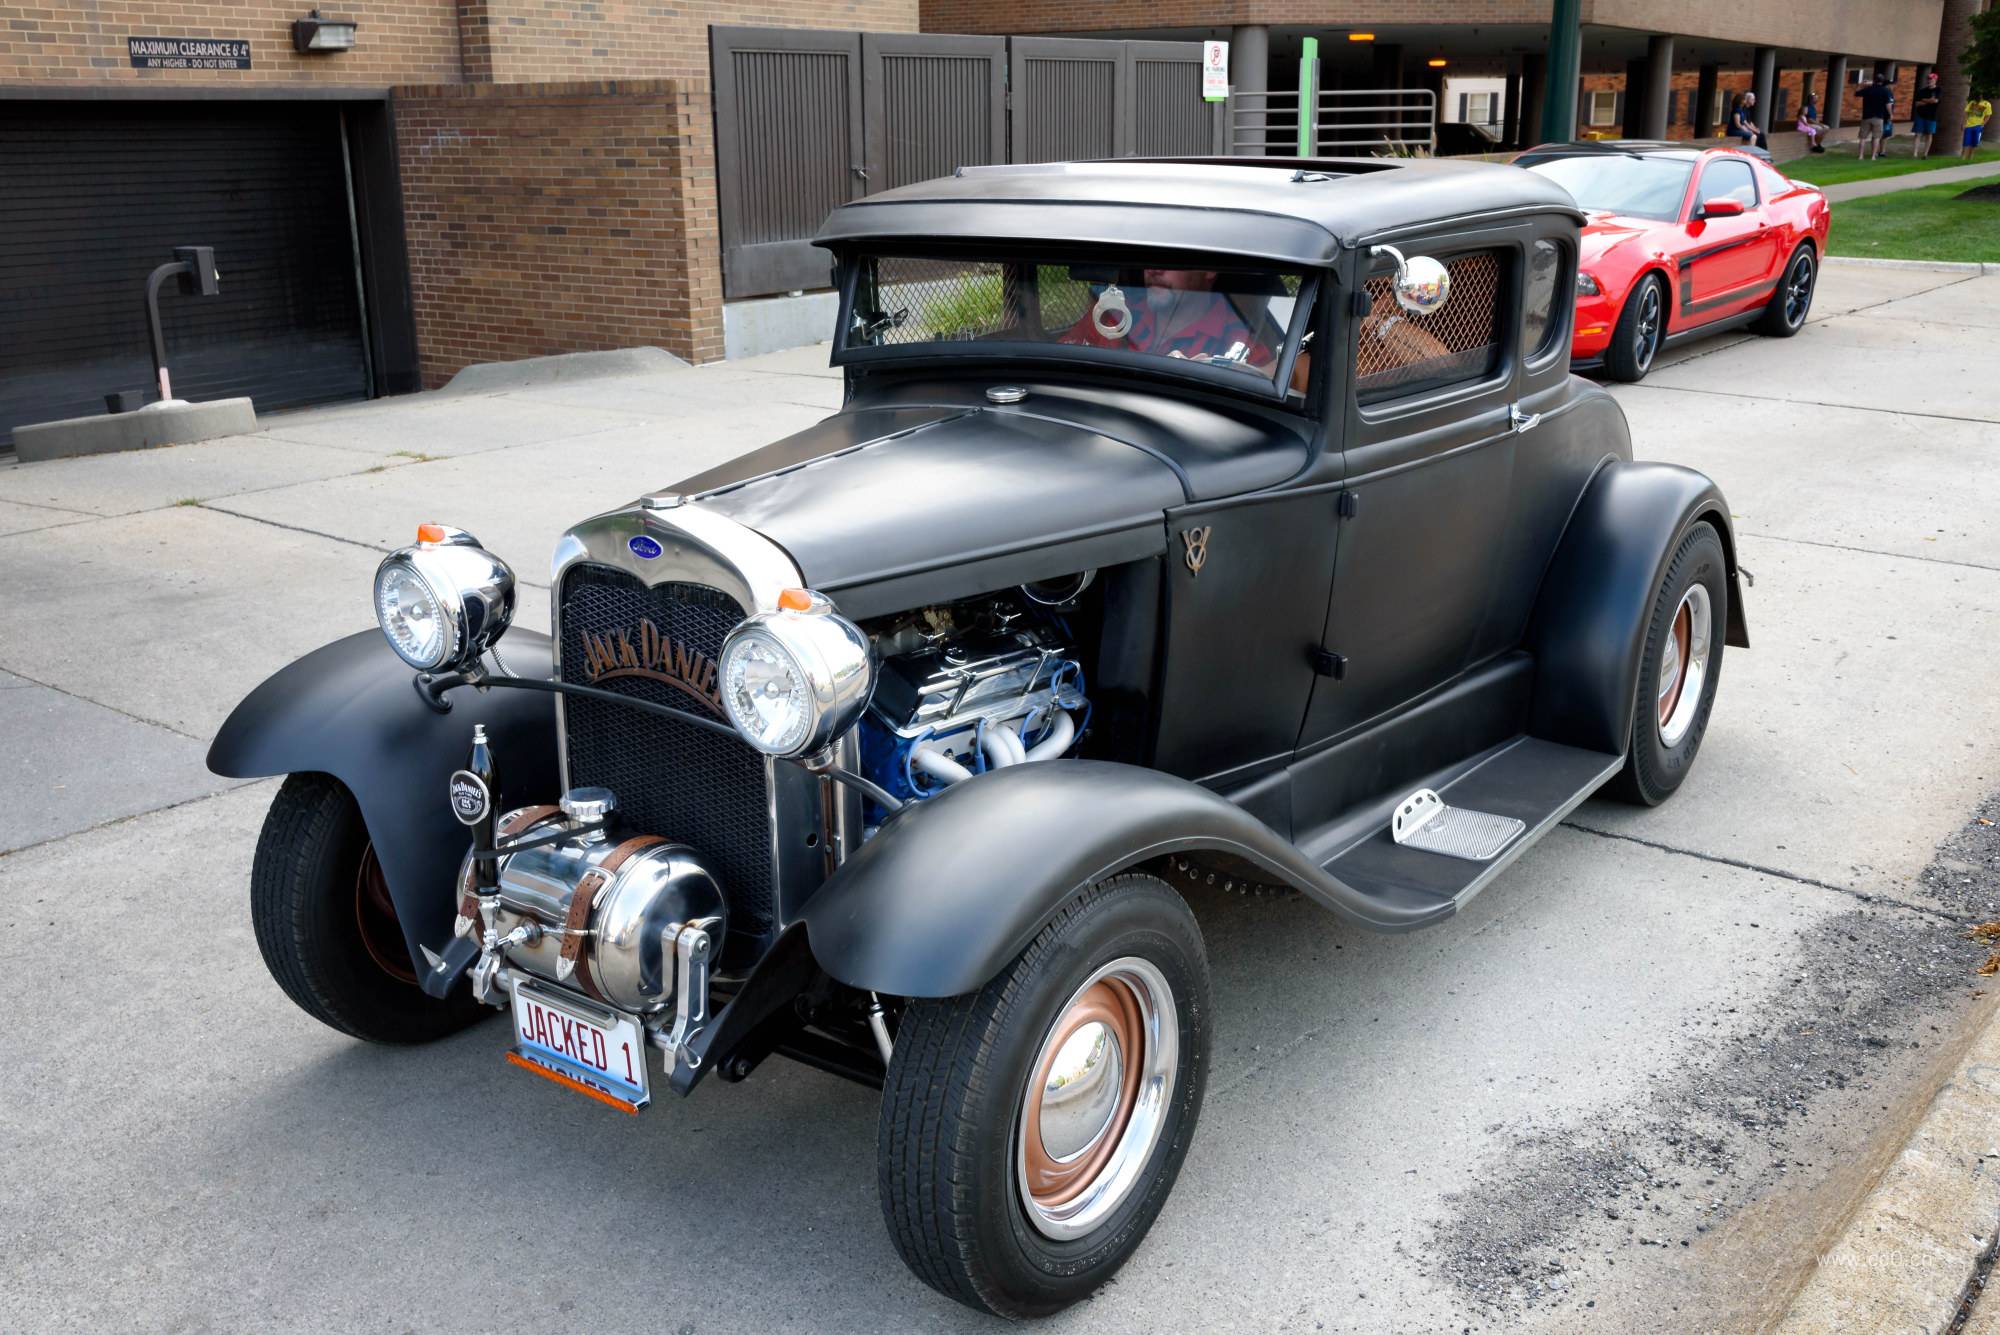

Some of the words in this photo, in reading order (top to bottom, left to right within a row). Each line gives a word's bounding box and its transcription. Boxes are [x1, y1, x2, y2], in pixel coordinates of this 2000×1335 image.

[130, 41, 179, 55] MAXIMUM
[180, 42, 231, 56] CLEARANCE
[232, 44, 239, 56] 6'
[240, 44, 249, 56] 4"
[147, 58, 162, 67] ANY
[162, 58, 187, 68] HIGHER
[192, 59, 202, 68] DO
[203, 59, 218, 68] NOT
[218, 59, 238, 69] ENTER
[632, 539, 658, 555] Ford
[580, 628, 639, 681] JACK
[522, 1002, 607, 1071] JACKED
[622, 1042, 637, 1086] 1
